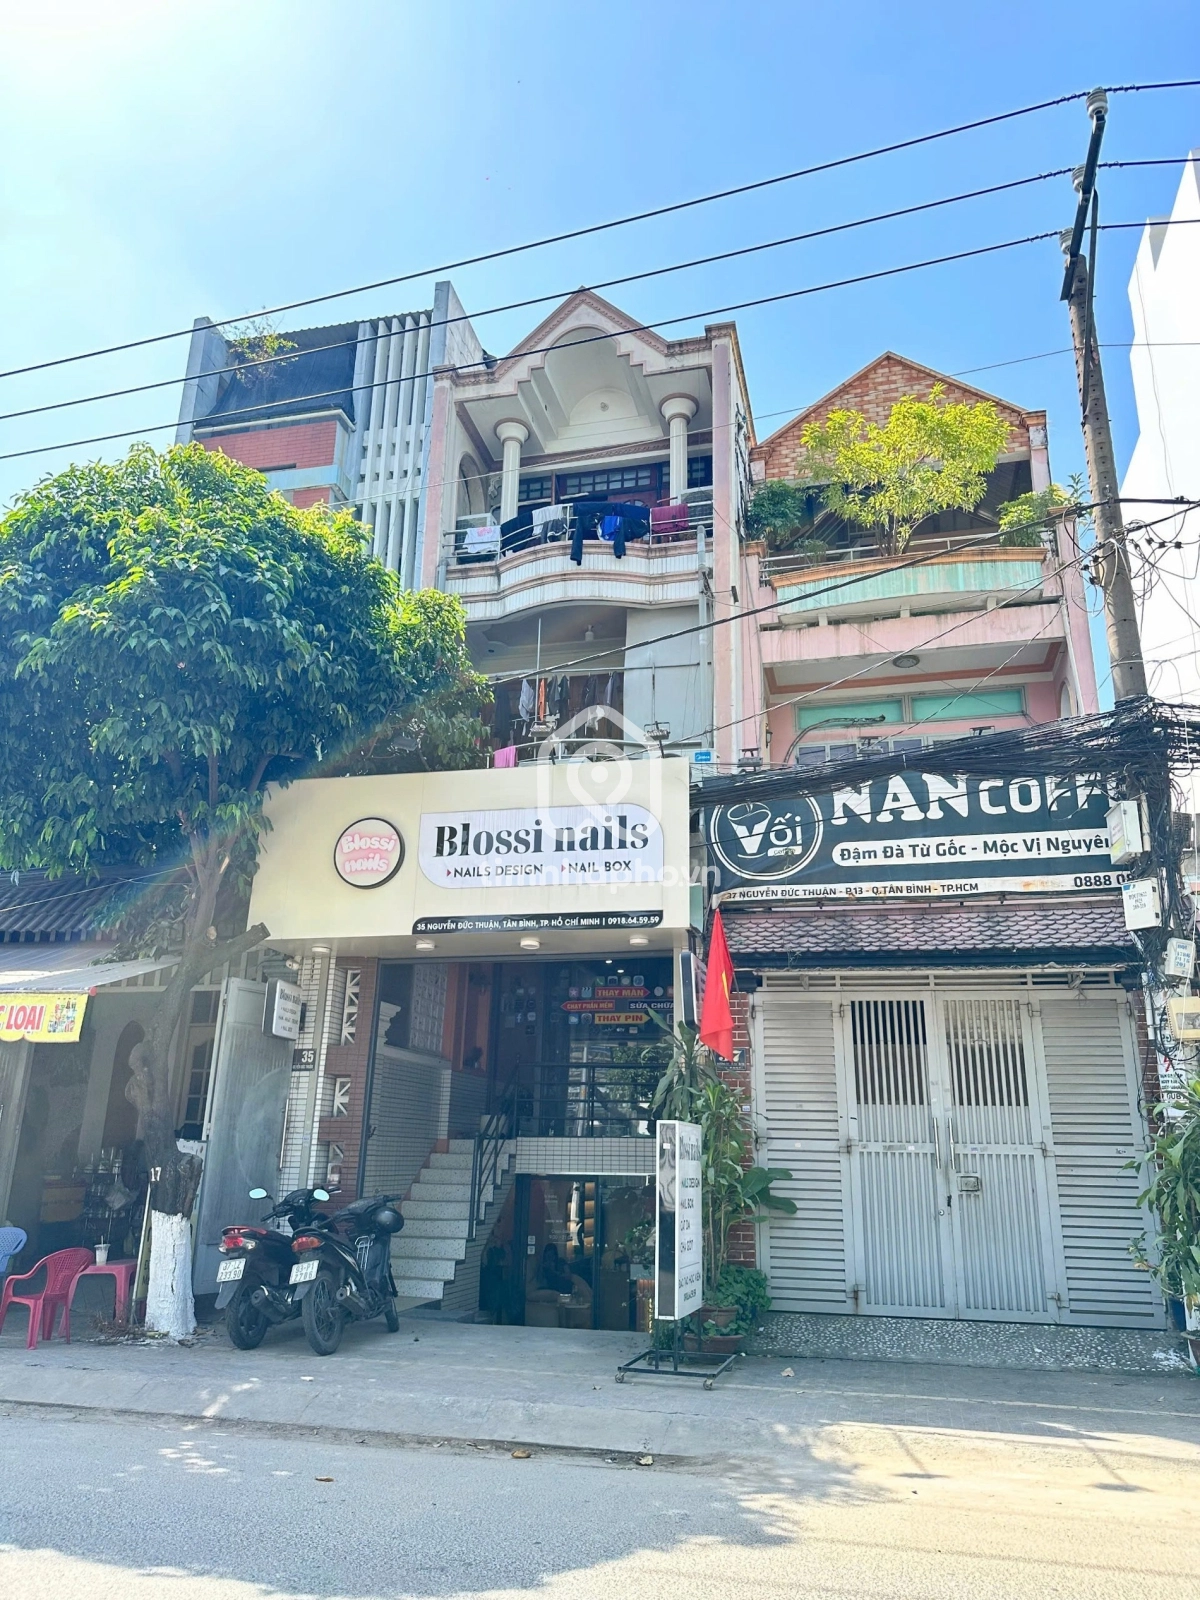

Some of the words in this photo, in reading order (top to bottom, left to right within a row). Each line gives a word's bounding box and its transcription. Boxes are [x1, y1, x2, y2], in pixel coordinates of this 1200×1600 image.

[341, 833, 398, 854] Blossi
[432, 818, 545, 858] Blossi
[553, 815, 650, 853] nails
[840, 847, 878, 864] Đậm
[882, 845, 905, 859] Đà
[908, 843, 931, 858] Từ
[935, 839, 967, 857] Gốc
[983, 839, 1019, 857] Mộc
[1022, 838, 1042, 855] Vị
[344, 853, 389, 873] nails
[453, 865, 491, 878] NAILS
[495, 863, 544, 877] DESIGN
[568, 861, 599, 874] NAIL
[604, 860, 632, 872] BOX
[1073, 874, 1112, 888] 0888
[739, 887, 779, 899] NGUYỄN
[781, 888, 800, 897] ĐỨC
[802, 888, 837, 899] THUẬN
[871, 884, 904, 895] Q.TÂN
[906, 883, 932, 894] BÌNH
[940, 882, 979, 893] TP.HCM
[416, 923, 426, 931] 35
[427, 920, 457, 931] NGUYỄN
[457, 921, 474, 930] ĐỨC
[475, 919, 501, 931] THUẬN,
[503, 920, 517, 928] TÂN
[518, 918, 539, 928] BÌNH,
[540, 919, 550, 927] TP.
[564, 916, 579, 926] CHÍ
[580, 917, 600, 926] MINH
[607, 916, 660, 925] 0918.64.59.59
[597, 989, 620, 997] THAY
[630, 1001, 648, 1009] SỬA
[624, 1014, 643, 1022] PIN
[301, 1050, 315, 1063] 35
[150, 1166, 162, 1182] 17
